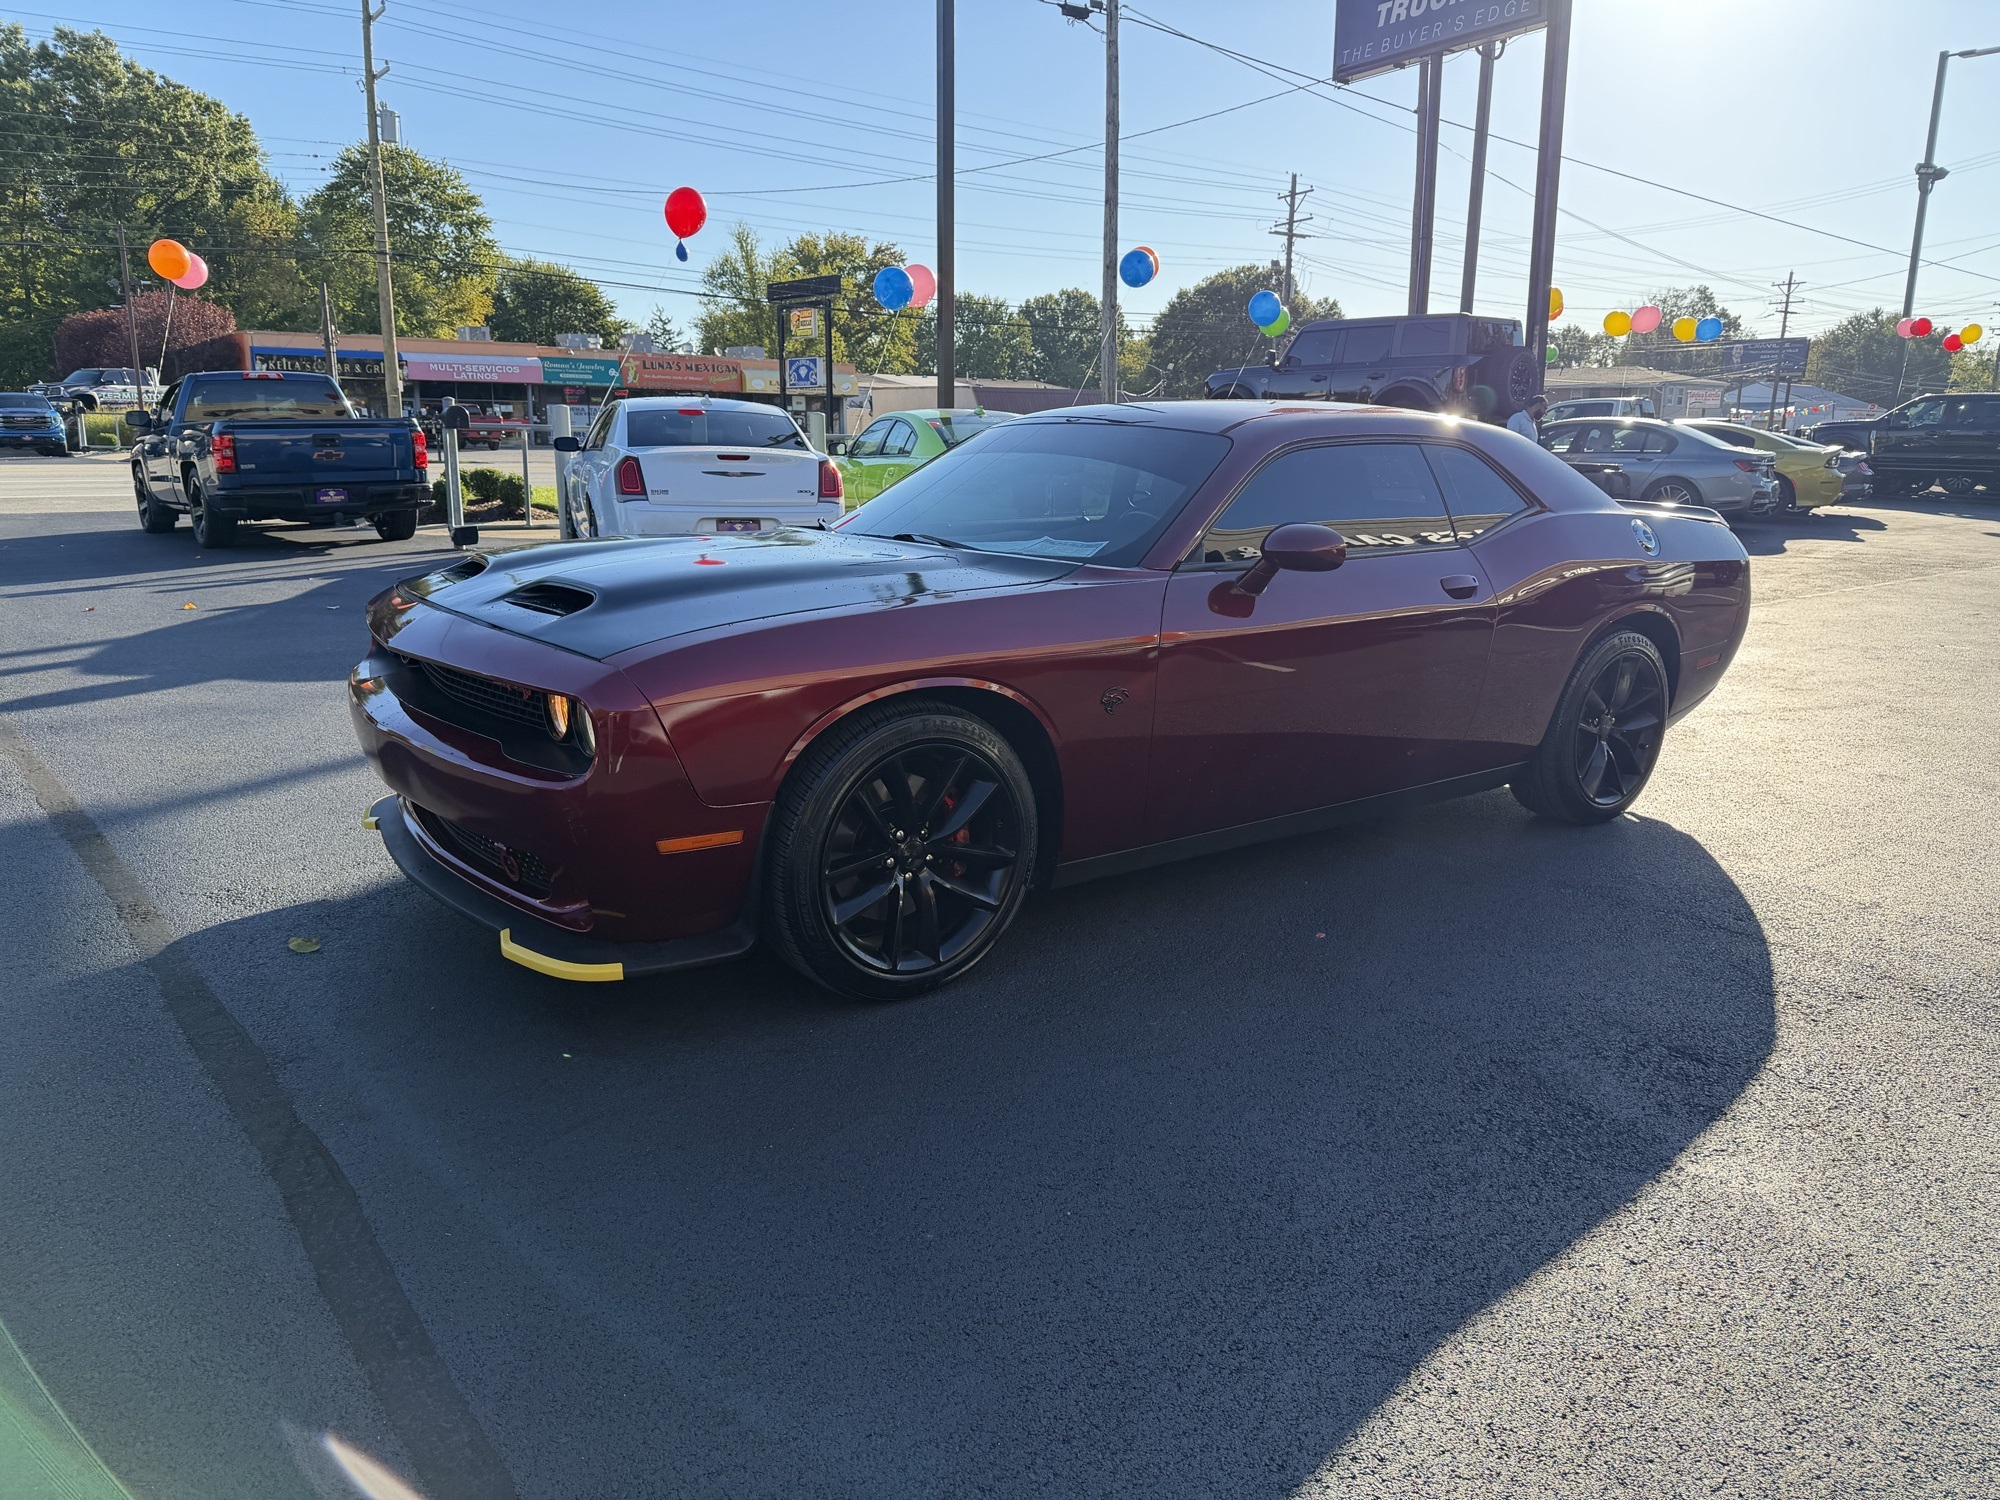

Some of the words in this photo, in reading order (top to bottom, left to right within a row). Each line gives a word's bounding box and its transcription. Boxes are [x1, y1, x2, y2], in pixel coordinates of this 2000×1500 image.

[1376, 0, 1466, 28] TRUC
[1342, 42, 1374, 65] THE
[1380, 15, 1466, 53] BUYER'S
[1473, 0, 1531, 26] EDGE
[268, 357, 311, 371] KEILA'S
[354, 363, 362, 373] &
[365, 362, 385, 374] GRI
[429, 363, 520, 373] MULTI-SERVICIOS
[542, 360, 575, 369] Roman's
[576, 362, 605, 371] Jewelry
[642, 360, 682, 371] LUNA'S
[685, 363, 739, 374] MEXICAN
[453, 371, 499, 380] LATINOS
[918, 718, 1005, 757] Firestone
